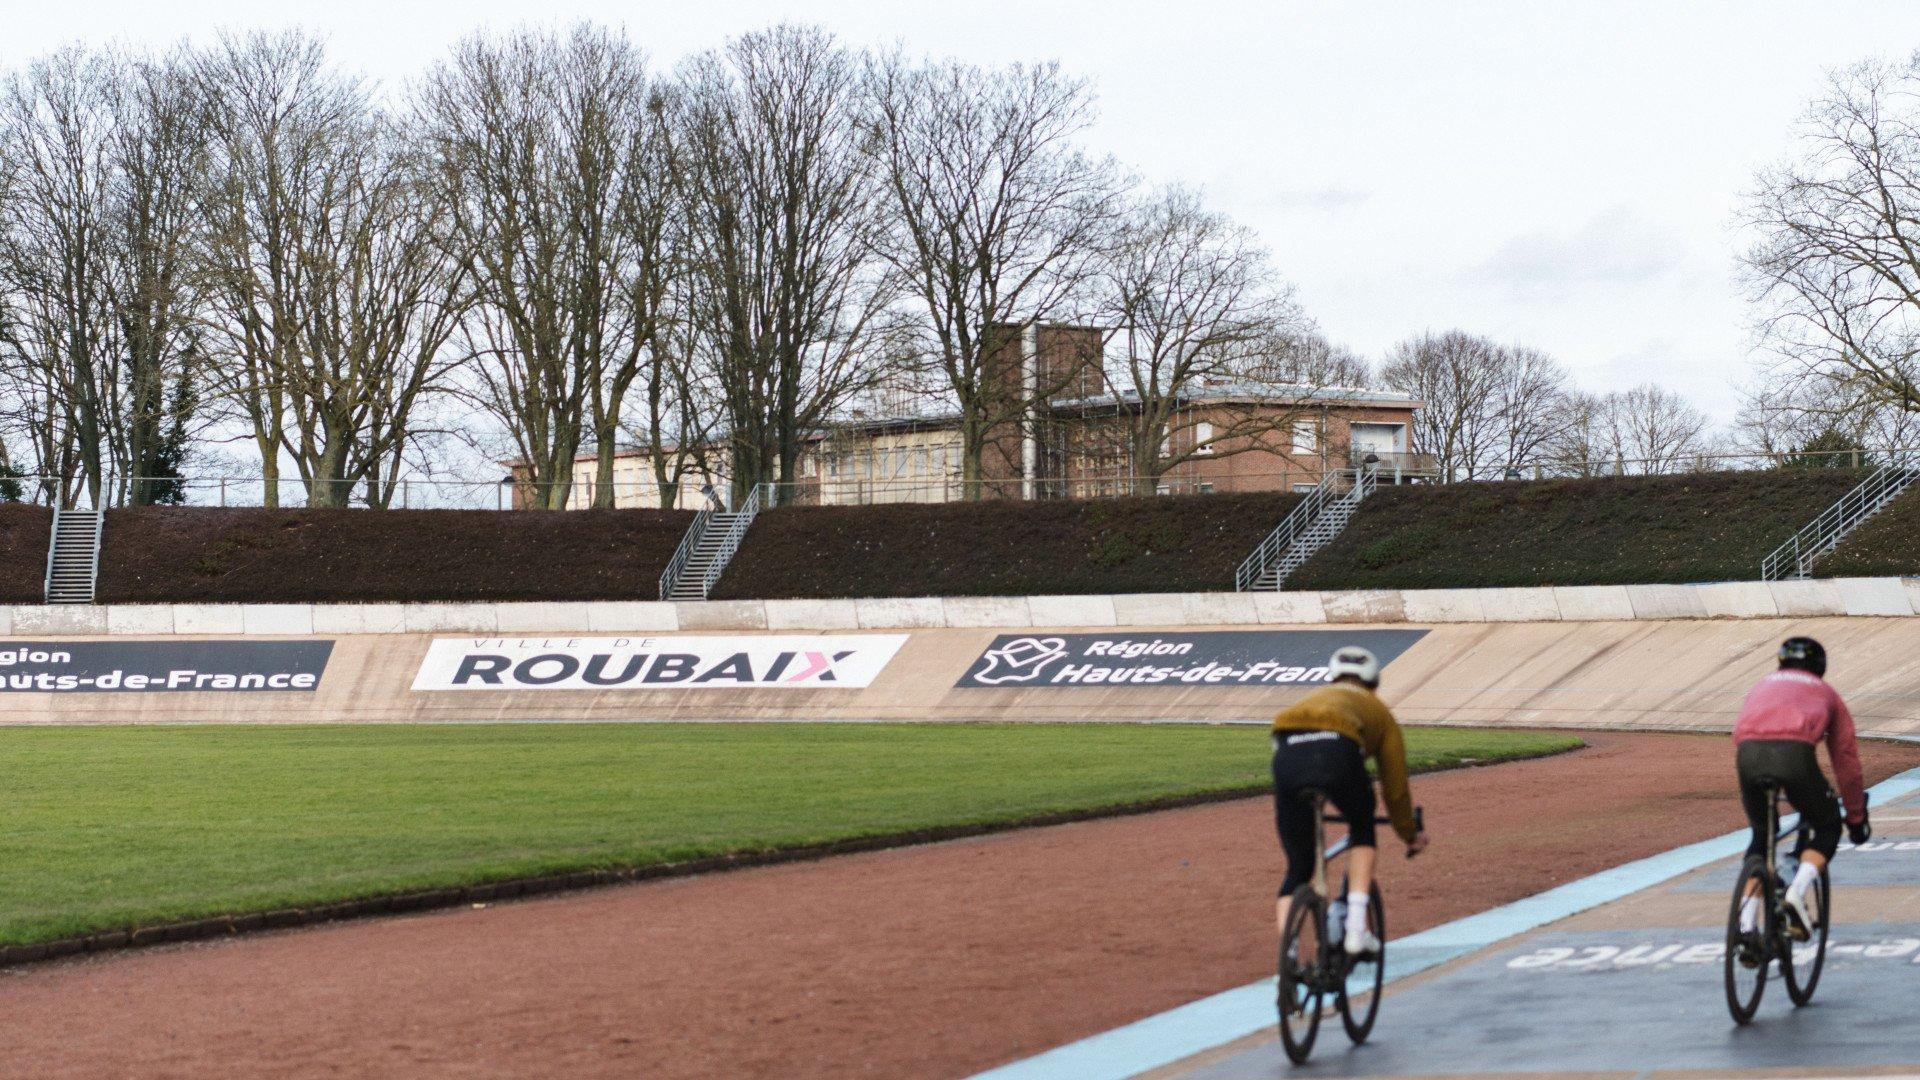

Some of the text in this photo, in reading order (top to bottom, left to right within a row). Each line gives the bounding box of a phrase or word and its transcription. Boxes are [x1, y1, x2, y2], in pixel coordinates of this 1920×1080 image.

[474, 638, 656, 648] VILLE DE
[1083, 639, 1194, 659] Région
[451, 651, 857, 686] ROUBAIX
